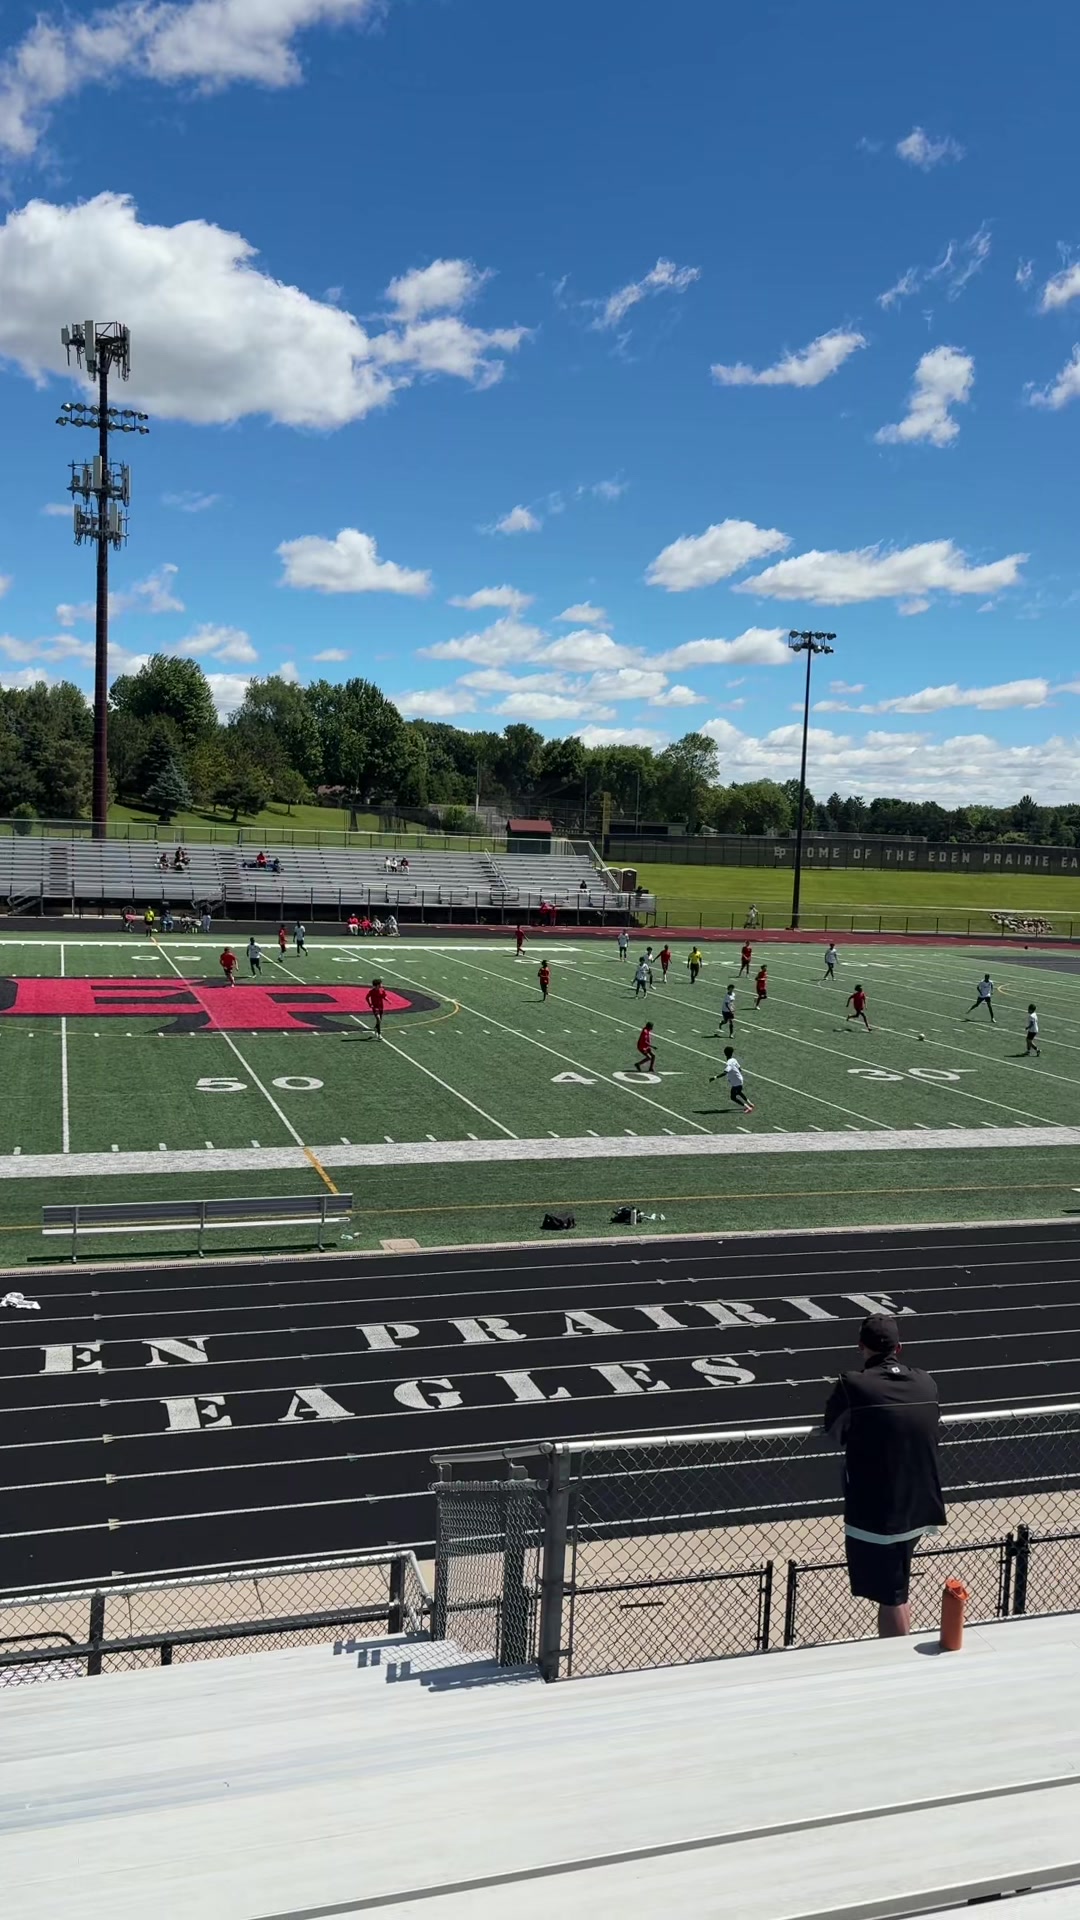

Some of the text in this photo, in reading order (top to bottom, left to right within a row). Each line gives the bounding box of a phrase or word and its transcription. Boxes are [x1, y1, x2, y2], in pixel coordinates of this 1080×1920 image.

[795, 847, 840, 859] OME
[853, 848, 872, 859] OF
[885, 849, 916, 861] THE
[928, 851, 970, 863] EDEN
[983, 852, 1050, 867] PRAIRIE
[550, 1071, 662, 1085] 40
[846, 1067, 961, 1081] 30
[194, 1076, 325, 1093] 50
[39, 1292, 917, 1374] EN PRAIRIE
[160, 1356, 757, 1431] EAGLES
